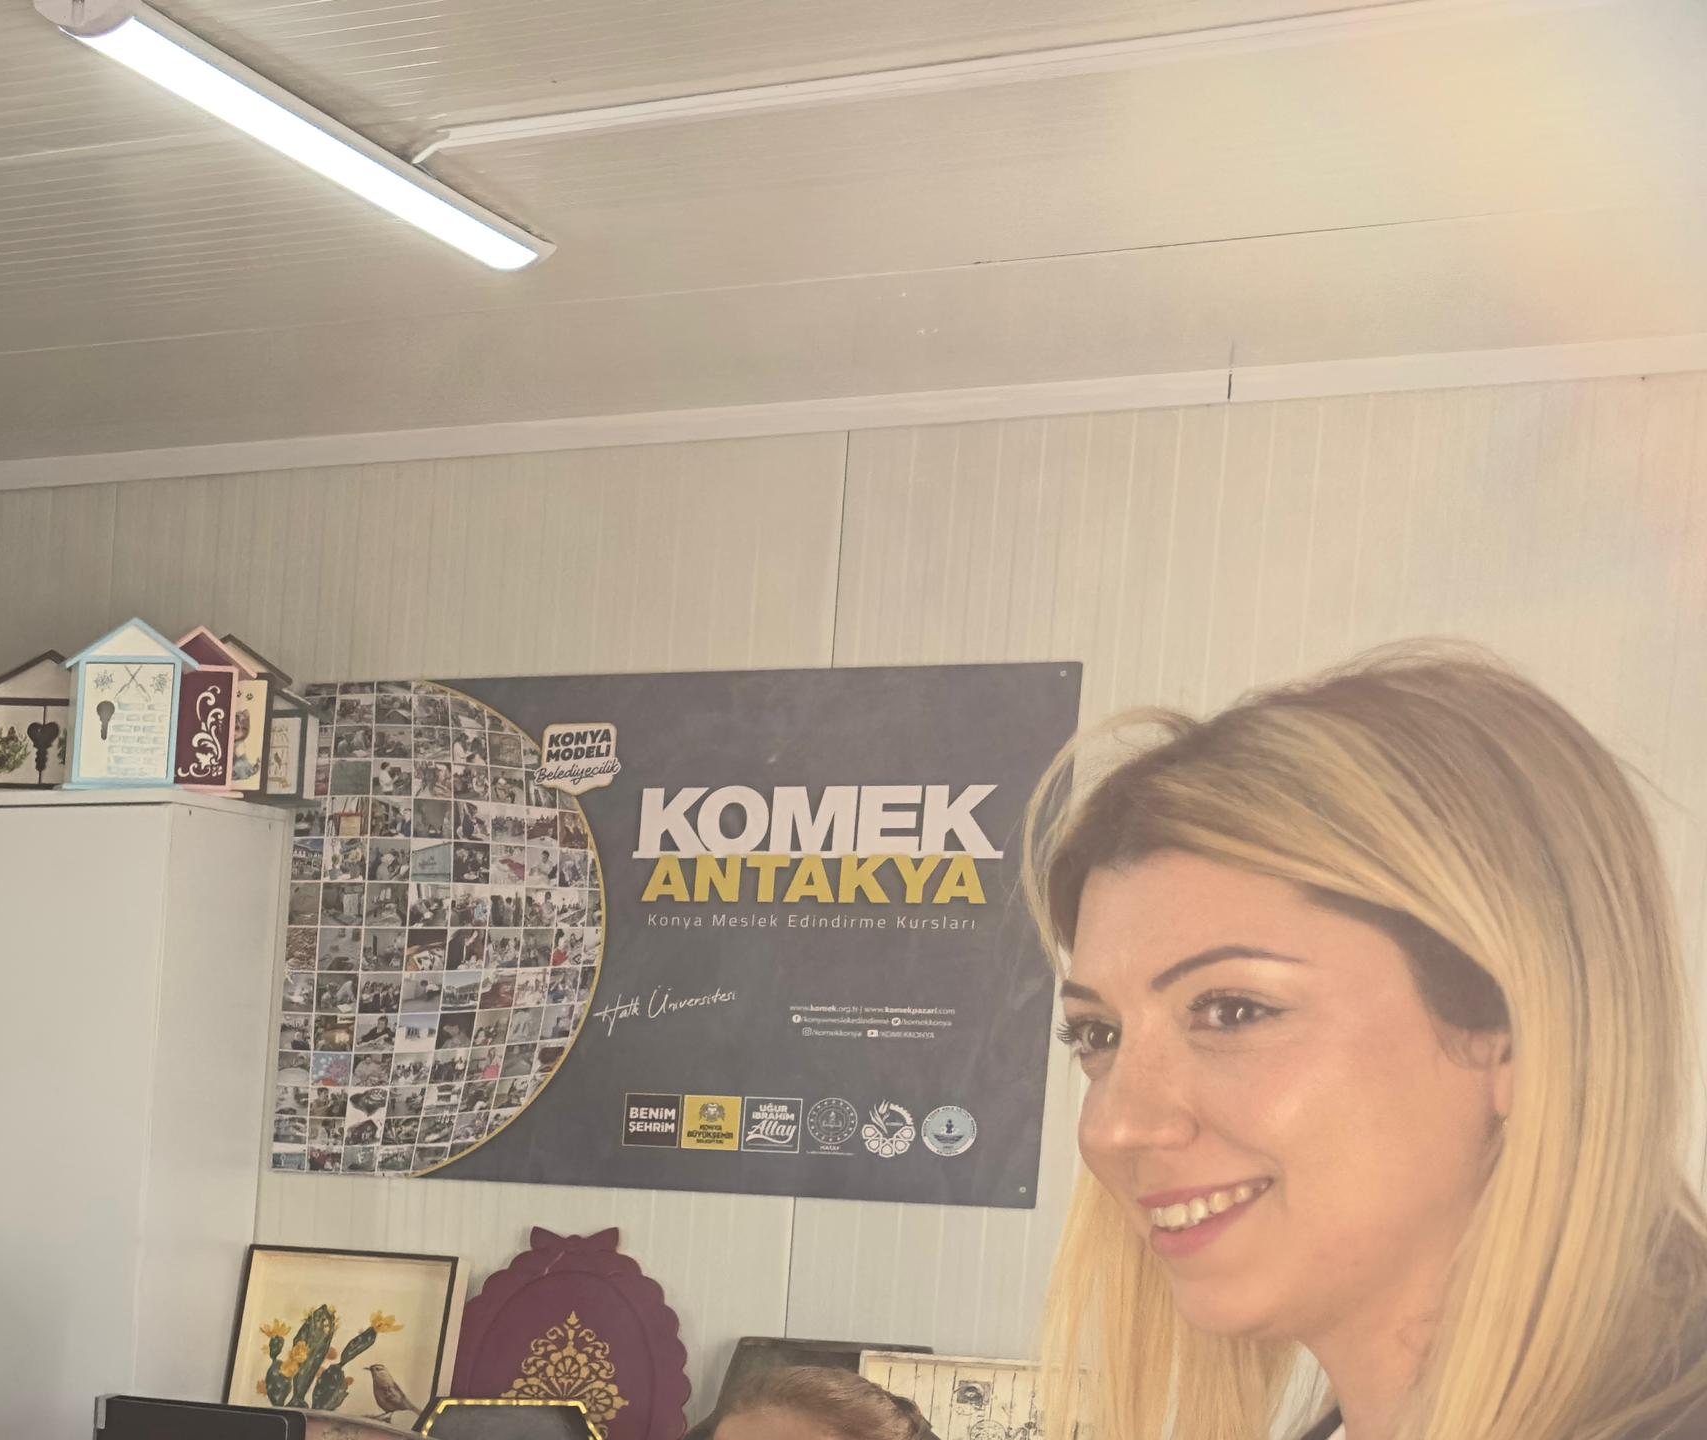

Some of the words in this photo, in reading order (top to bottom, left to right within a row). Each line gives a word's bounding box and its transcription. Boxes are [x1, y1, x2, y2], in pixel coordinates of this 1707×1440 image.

[548, 728, 612, 748] KONYA
[534, 758, 620, 786] Belediyecilik
[633, 784, 1003, 859] KOMEK
[641, 854, 987, 905] ANTAKYA
[647, 913, 703, 930] Konya
[711, 912, 779, 928] Meslek
[787, 913, 887, 929] Edindirme
[895, 914, 976, 930] Kursları
[628, 1106, 677, 1121] BENİM
[758, 1103, 788, 1113] UĞUR
[628, 1120, 675, 1134] ŞEHRİM
[747, 1119, 798, 1144] Altay
